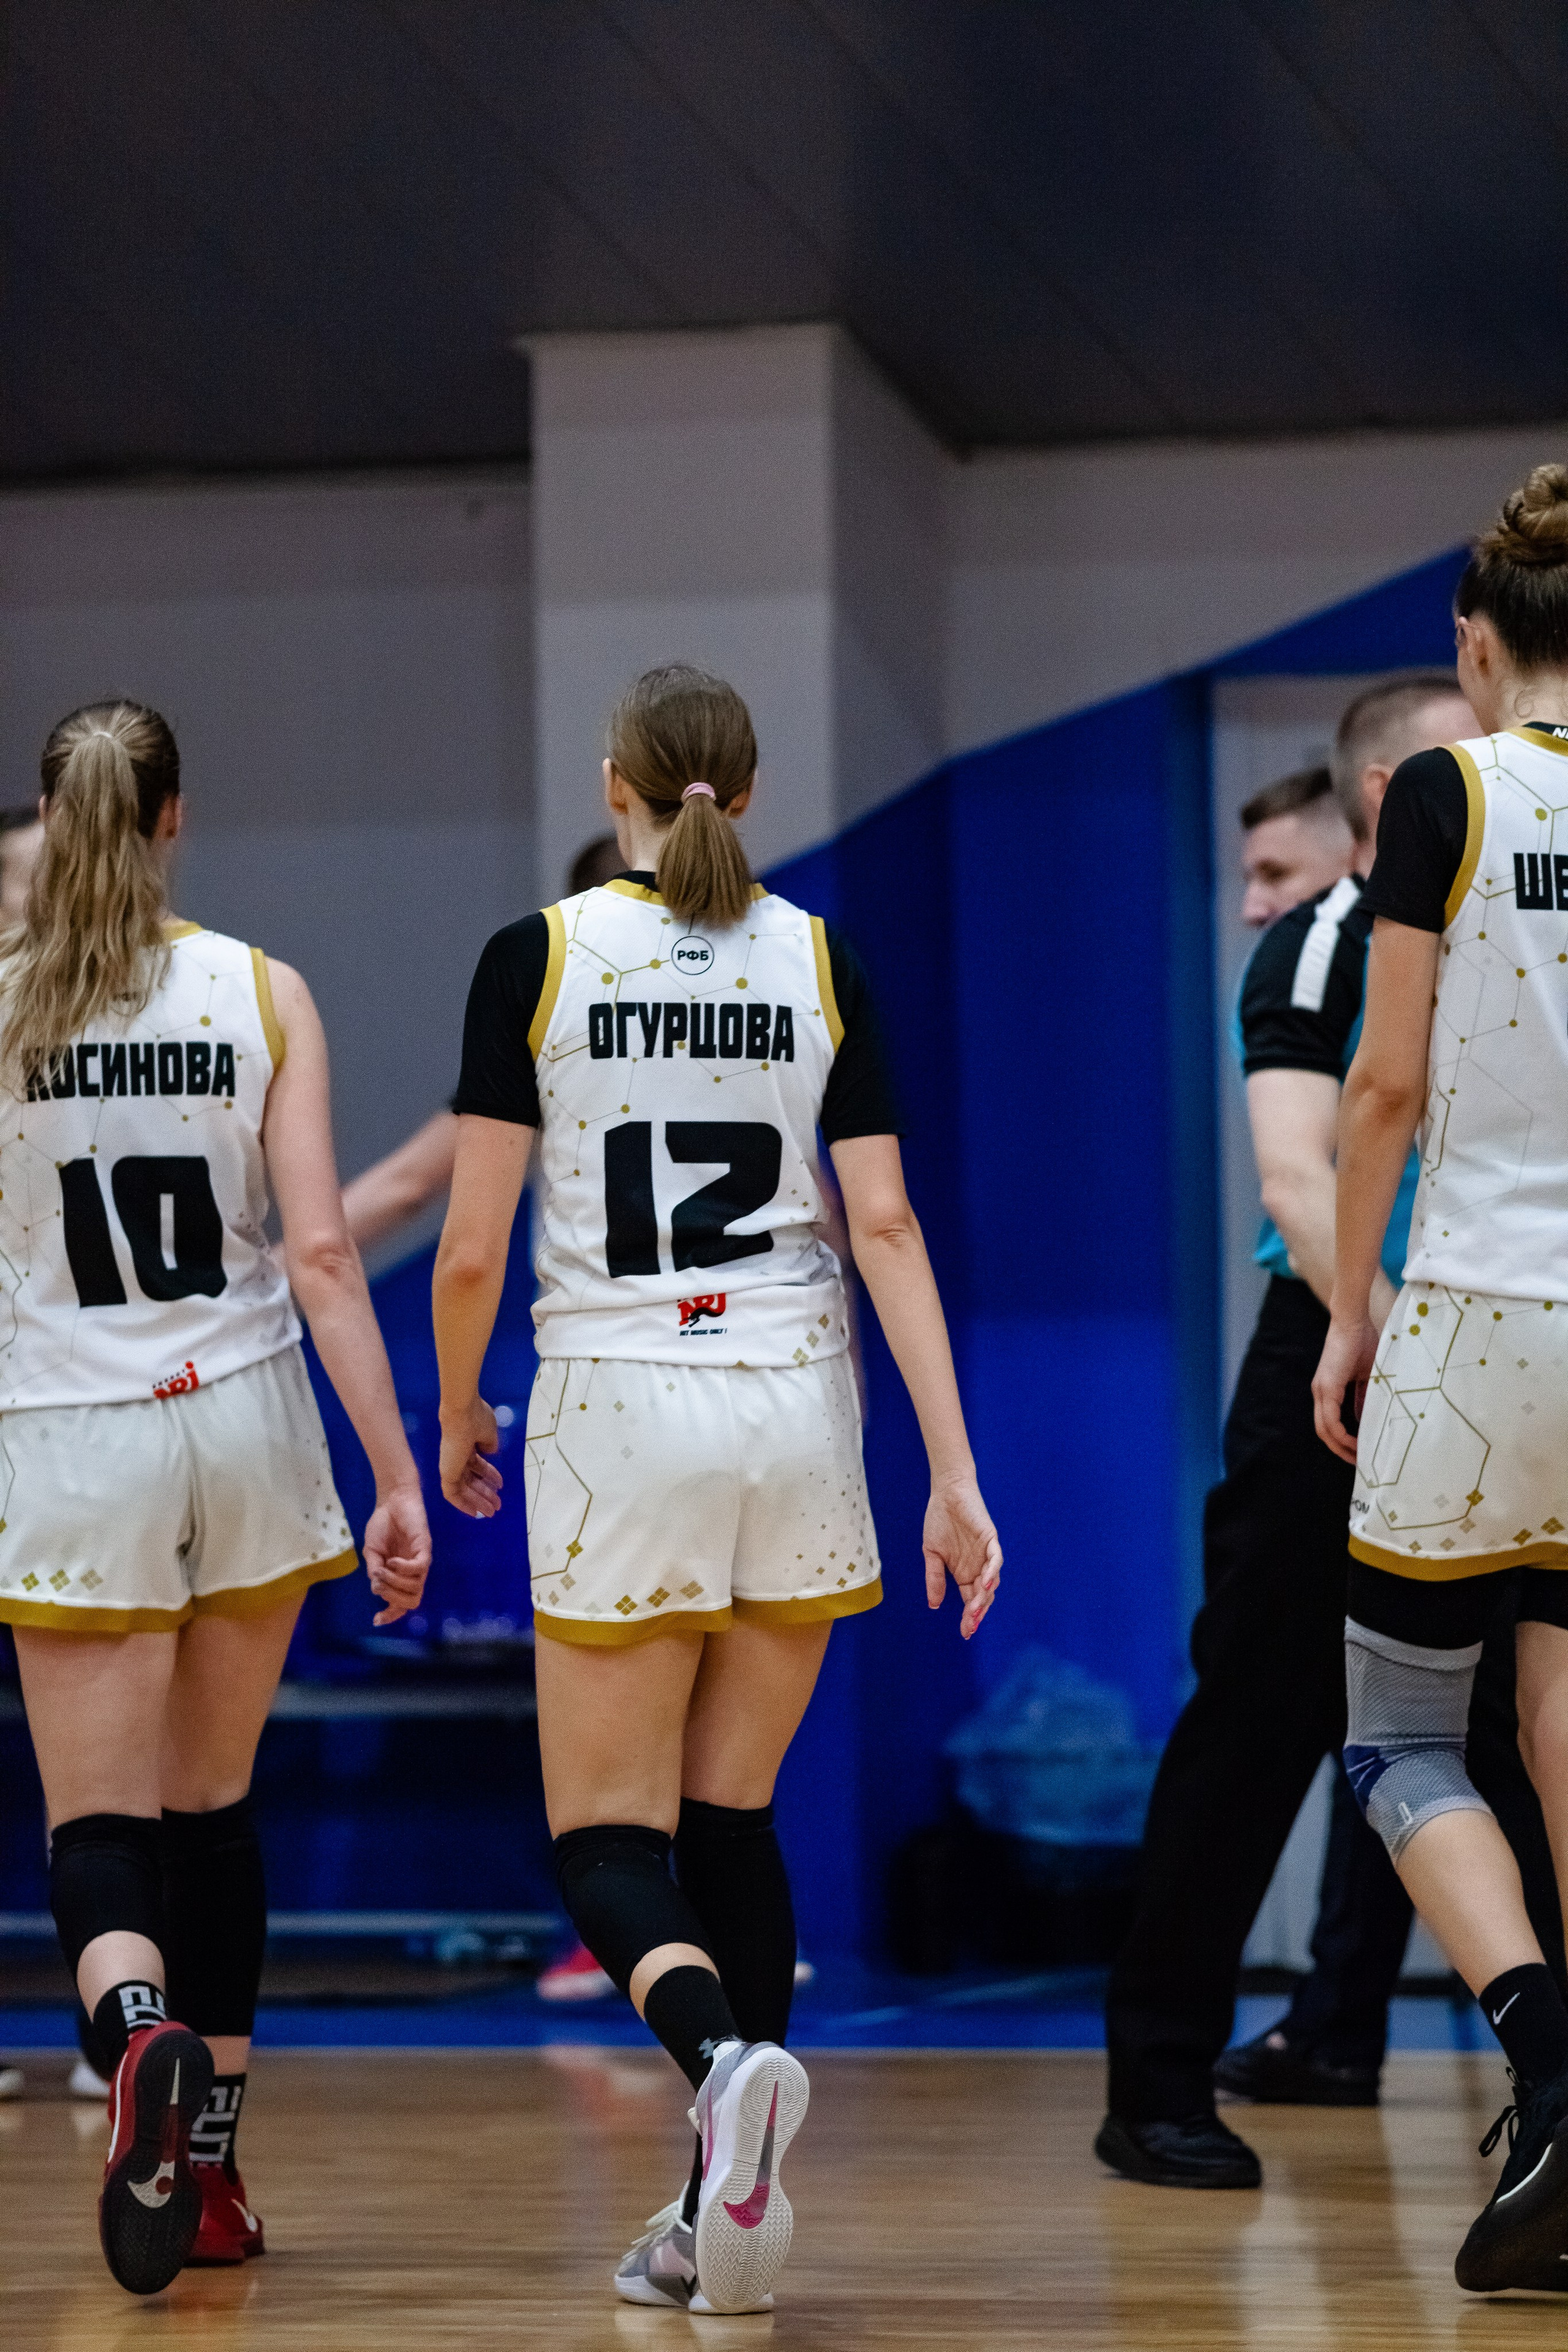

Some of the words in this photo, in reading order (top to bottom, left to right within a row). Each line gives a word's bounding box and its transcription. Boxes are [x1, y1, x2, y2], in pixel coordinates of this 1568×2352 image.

[677, 950, 709, 960] РФБ
[589, 1002, 794, 1062] ОГУРЦОВА
[59, 1155, 228, 1308] 10
[605, 1121, 782, 1279] 12
